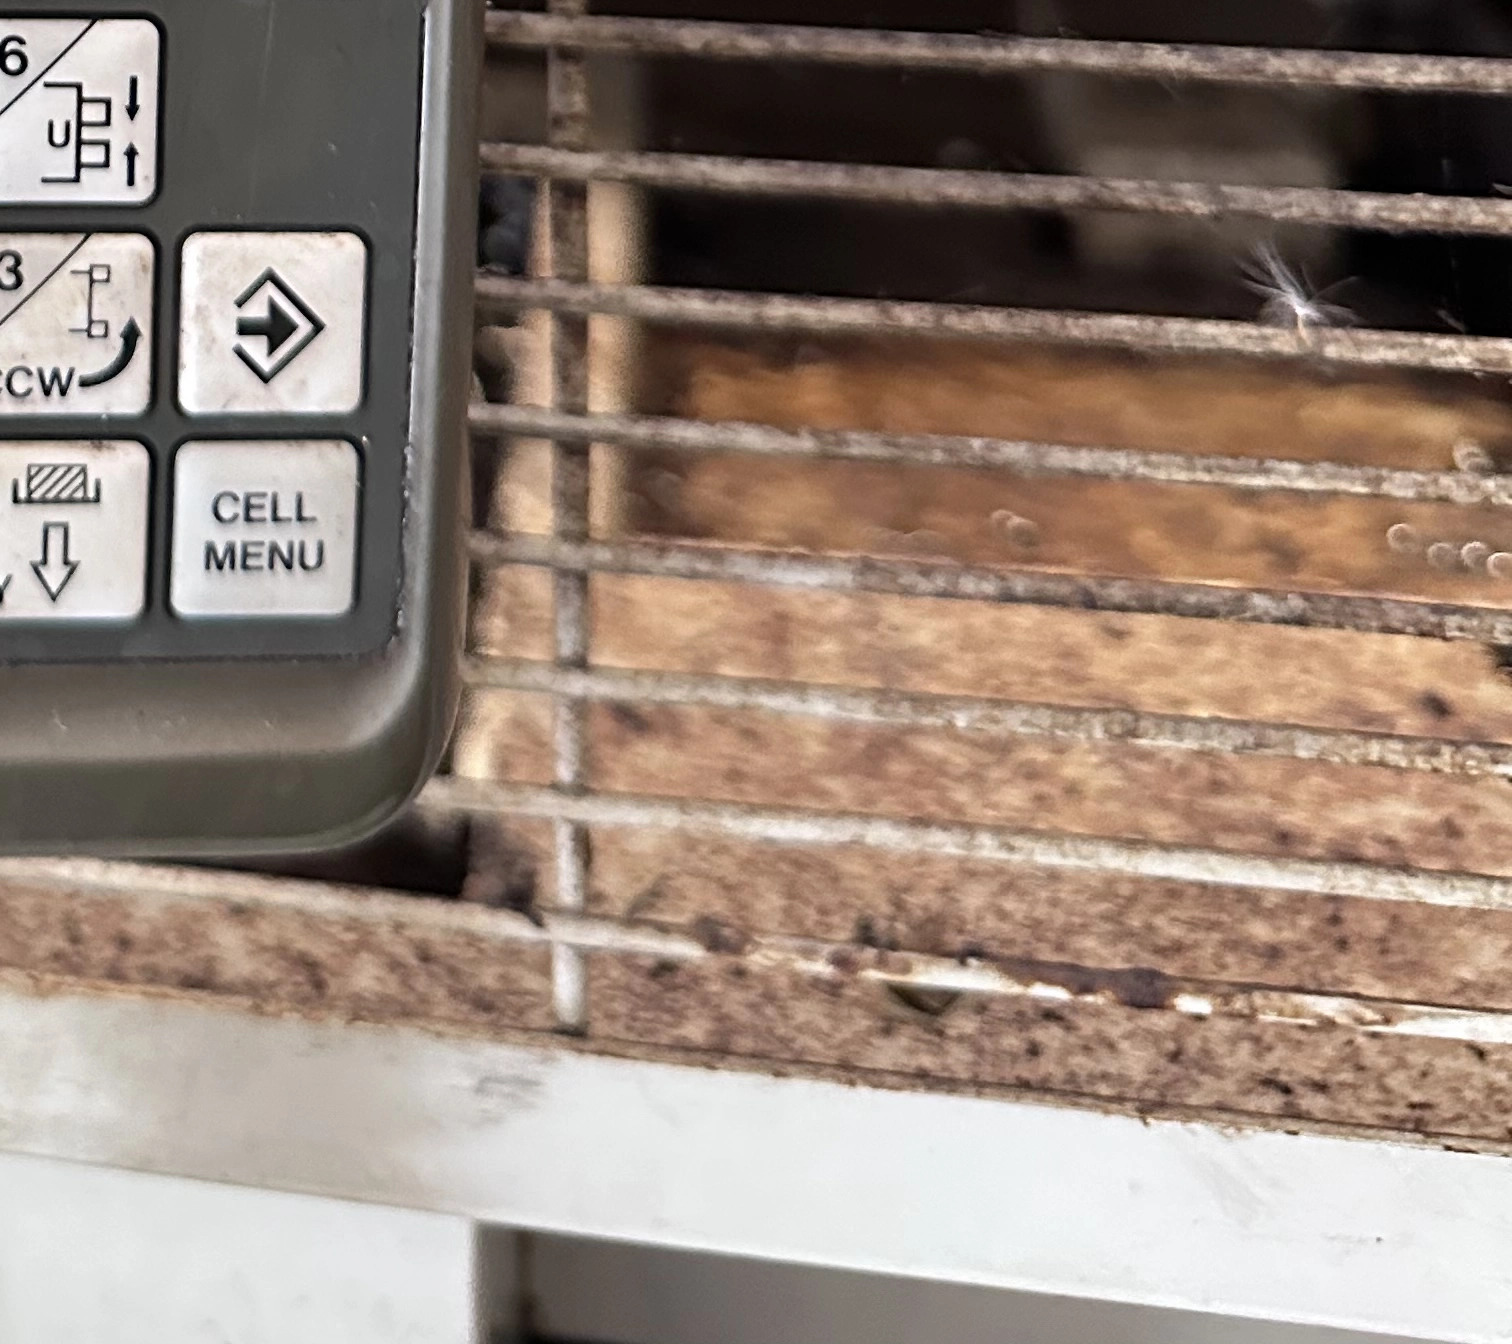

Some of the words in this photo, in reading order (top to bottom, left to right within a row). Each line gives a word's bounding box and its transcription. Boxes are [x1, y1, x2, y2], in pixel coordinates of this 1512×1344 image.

[48, 119, 71, 148] U
[211, 491, 317, 524] CELL
[204, 539, 325, 572] MENU
